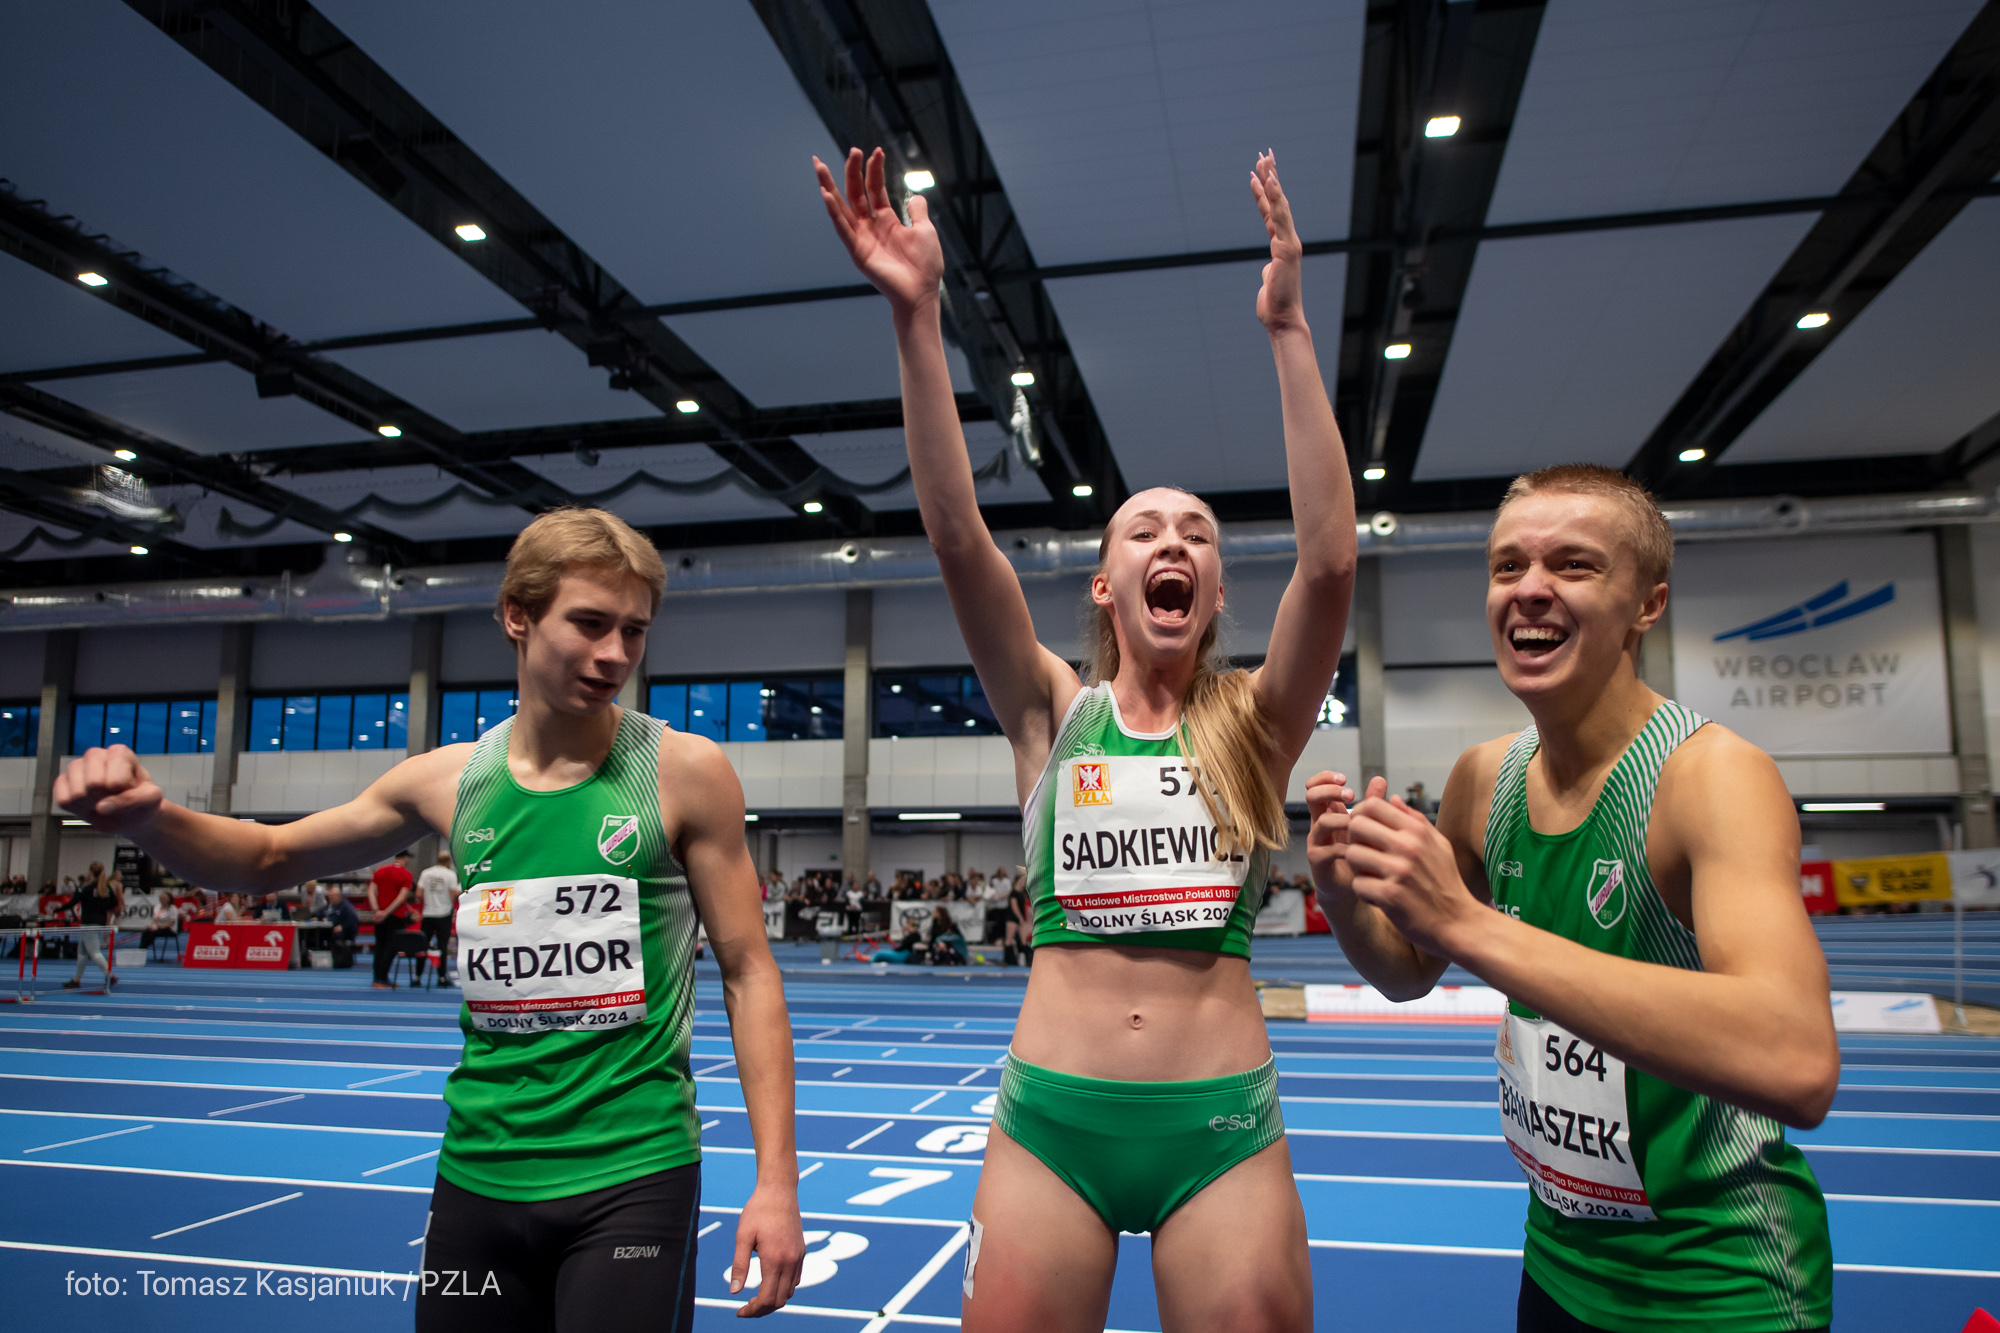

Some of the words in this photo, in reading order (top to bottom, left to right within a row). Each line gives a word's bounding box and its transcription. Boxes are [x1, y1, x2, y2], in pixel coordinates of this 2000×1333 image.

[1731, 683, 1887, 708] AIRPORT
[1073, 741, 1105, 756] esa
[1160, 766, 1219, 796] 57
[1075, 791, 1110, 804] PZLA
[465, 827, 495, 843] esa
[554, 883, 623, 915] 572
[1062, 898, 1082, 908] PZLA
[1084, 896, 1121, 907] Halowe
[1123, 891, 1183, 904] Mistrzostwa
[1185, 889, 1214, 900] Polski
[1215, 889, 1231, 898] U18
[480, 912, 510, 924] PZLA
[1079, 914, 1136, 928] DOLNY
[1140, 908, 1198, 926] ŚLĄSK
[467, 939, 634, 987] KĘDZIOR
[490, 1003, 520, 1011] Halowe
[521, 1001, 572, 1011] Mistrzostwa
[573, 997, 599, 1008] Polski
[600, 996, 617, 1005] U18
[622, 993, 640, 1003] U20
[487, 1017, 533, 1028] DOLNY
[538, 1013, 585, 1027] ŚLĄSK
[588, 1011, 628, 1025] 2024
[1545, 1034, 1607, 1082] 564
[1209, 1113, 1256, 1132] esa
[1500, 1076, 1627, 1164] BANASZEK
[846, 1167, 953, 1206] 7
[1567, 1179, 1593, 1195] Polski
[1594, 1187, 1613, 1199] U18
[1620, 1191, 1641, 1203] U20
[1585, 1203, 1634, 1219] 2024
[723, 1231, 869, 1289] 8
